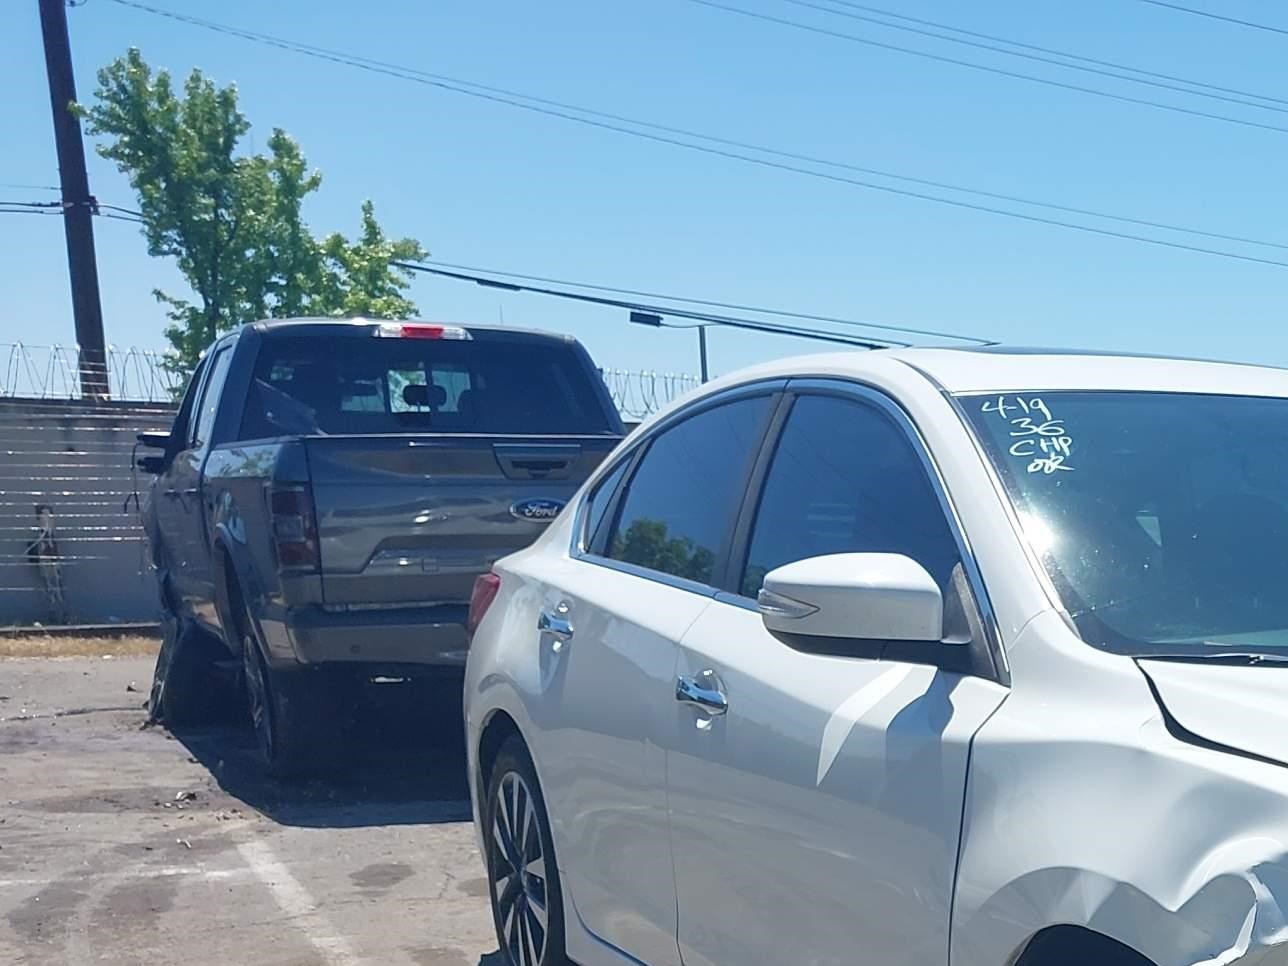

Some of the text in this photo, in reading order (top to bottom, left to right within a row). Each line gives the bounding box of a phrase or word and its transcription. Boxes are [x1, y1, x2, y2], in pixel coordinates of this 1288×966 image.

[982, 396, 1052, 420] 4-19
[1009, 418, 1065, 436] 36
[525, 504, 558, 517] Ford
